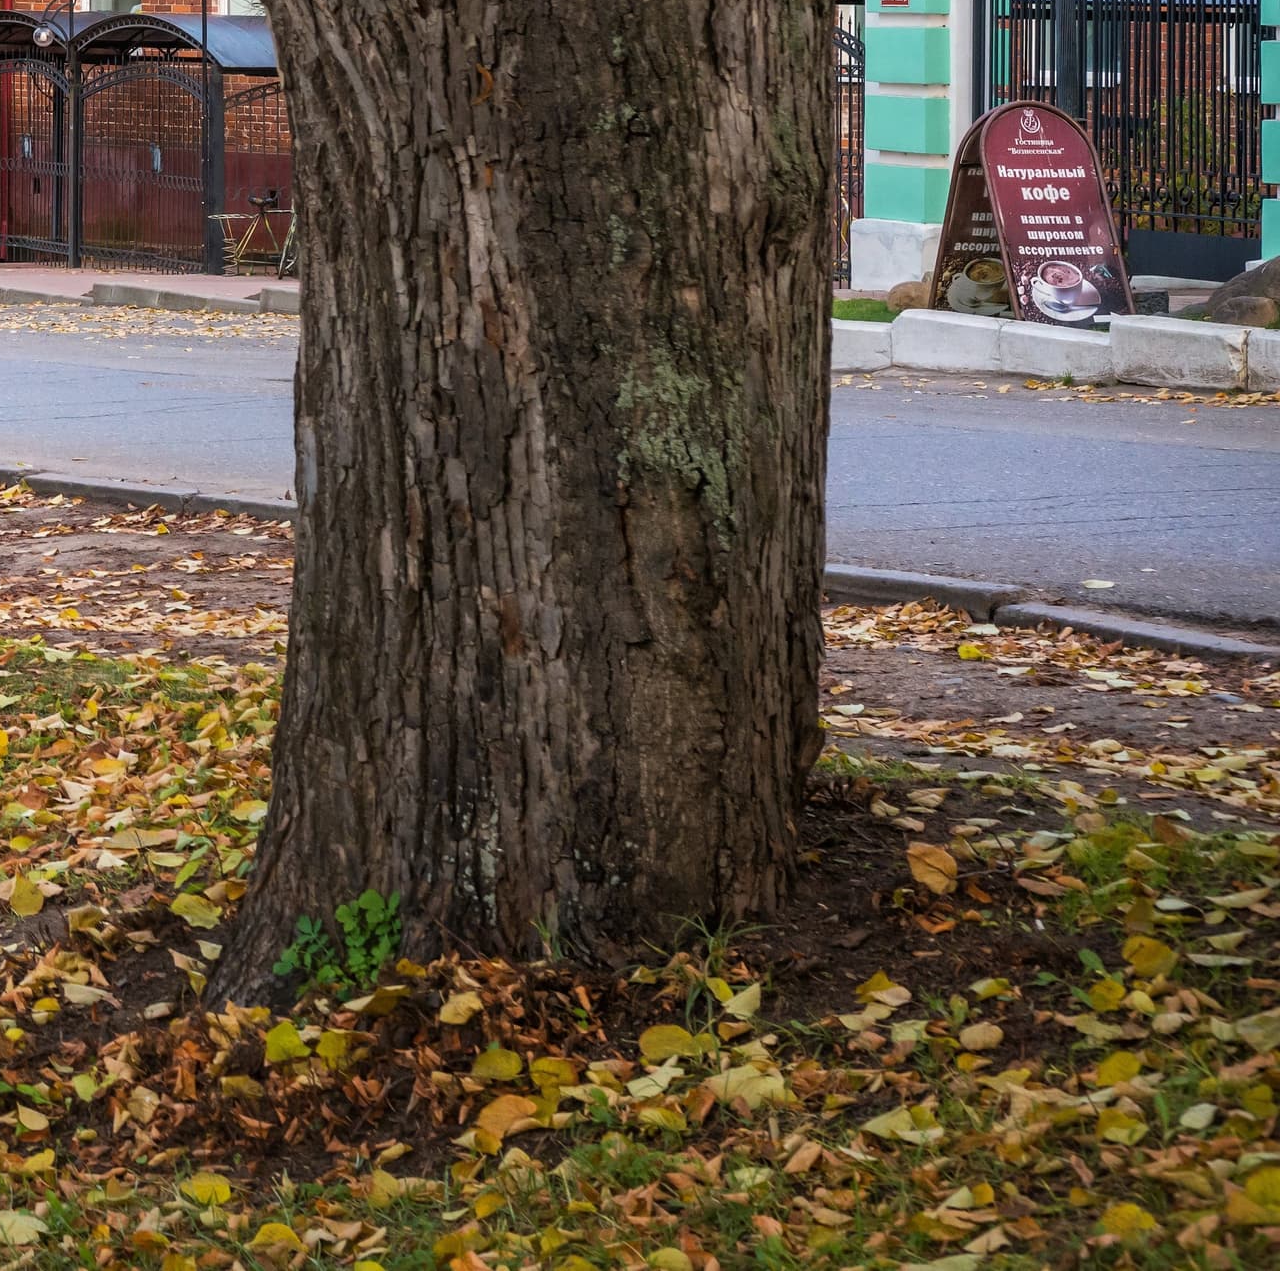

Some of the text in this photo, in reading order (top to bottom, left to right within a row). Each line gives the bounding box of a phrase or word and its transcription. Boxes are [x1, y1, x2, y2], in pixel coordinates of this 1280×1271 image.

[1014, 138, 1054, 147] Гостиница
[997, 165, 1086, 179] Натуральный
[1021, 184, 1070, 204] кофе
[1021, 215, 1084, 225] напитки в
[1027, 230, 1084, 241] широком
[1018, 245, 1104, 256] ассортименте
